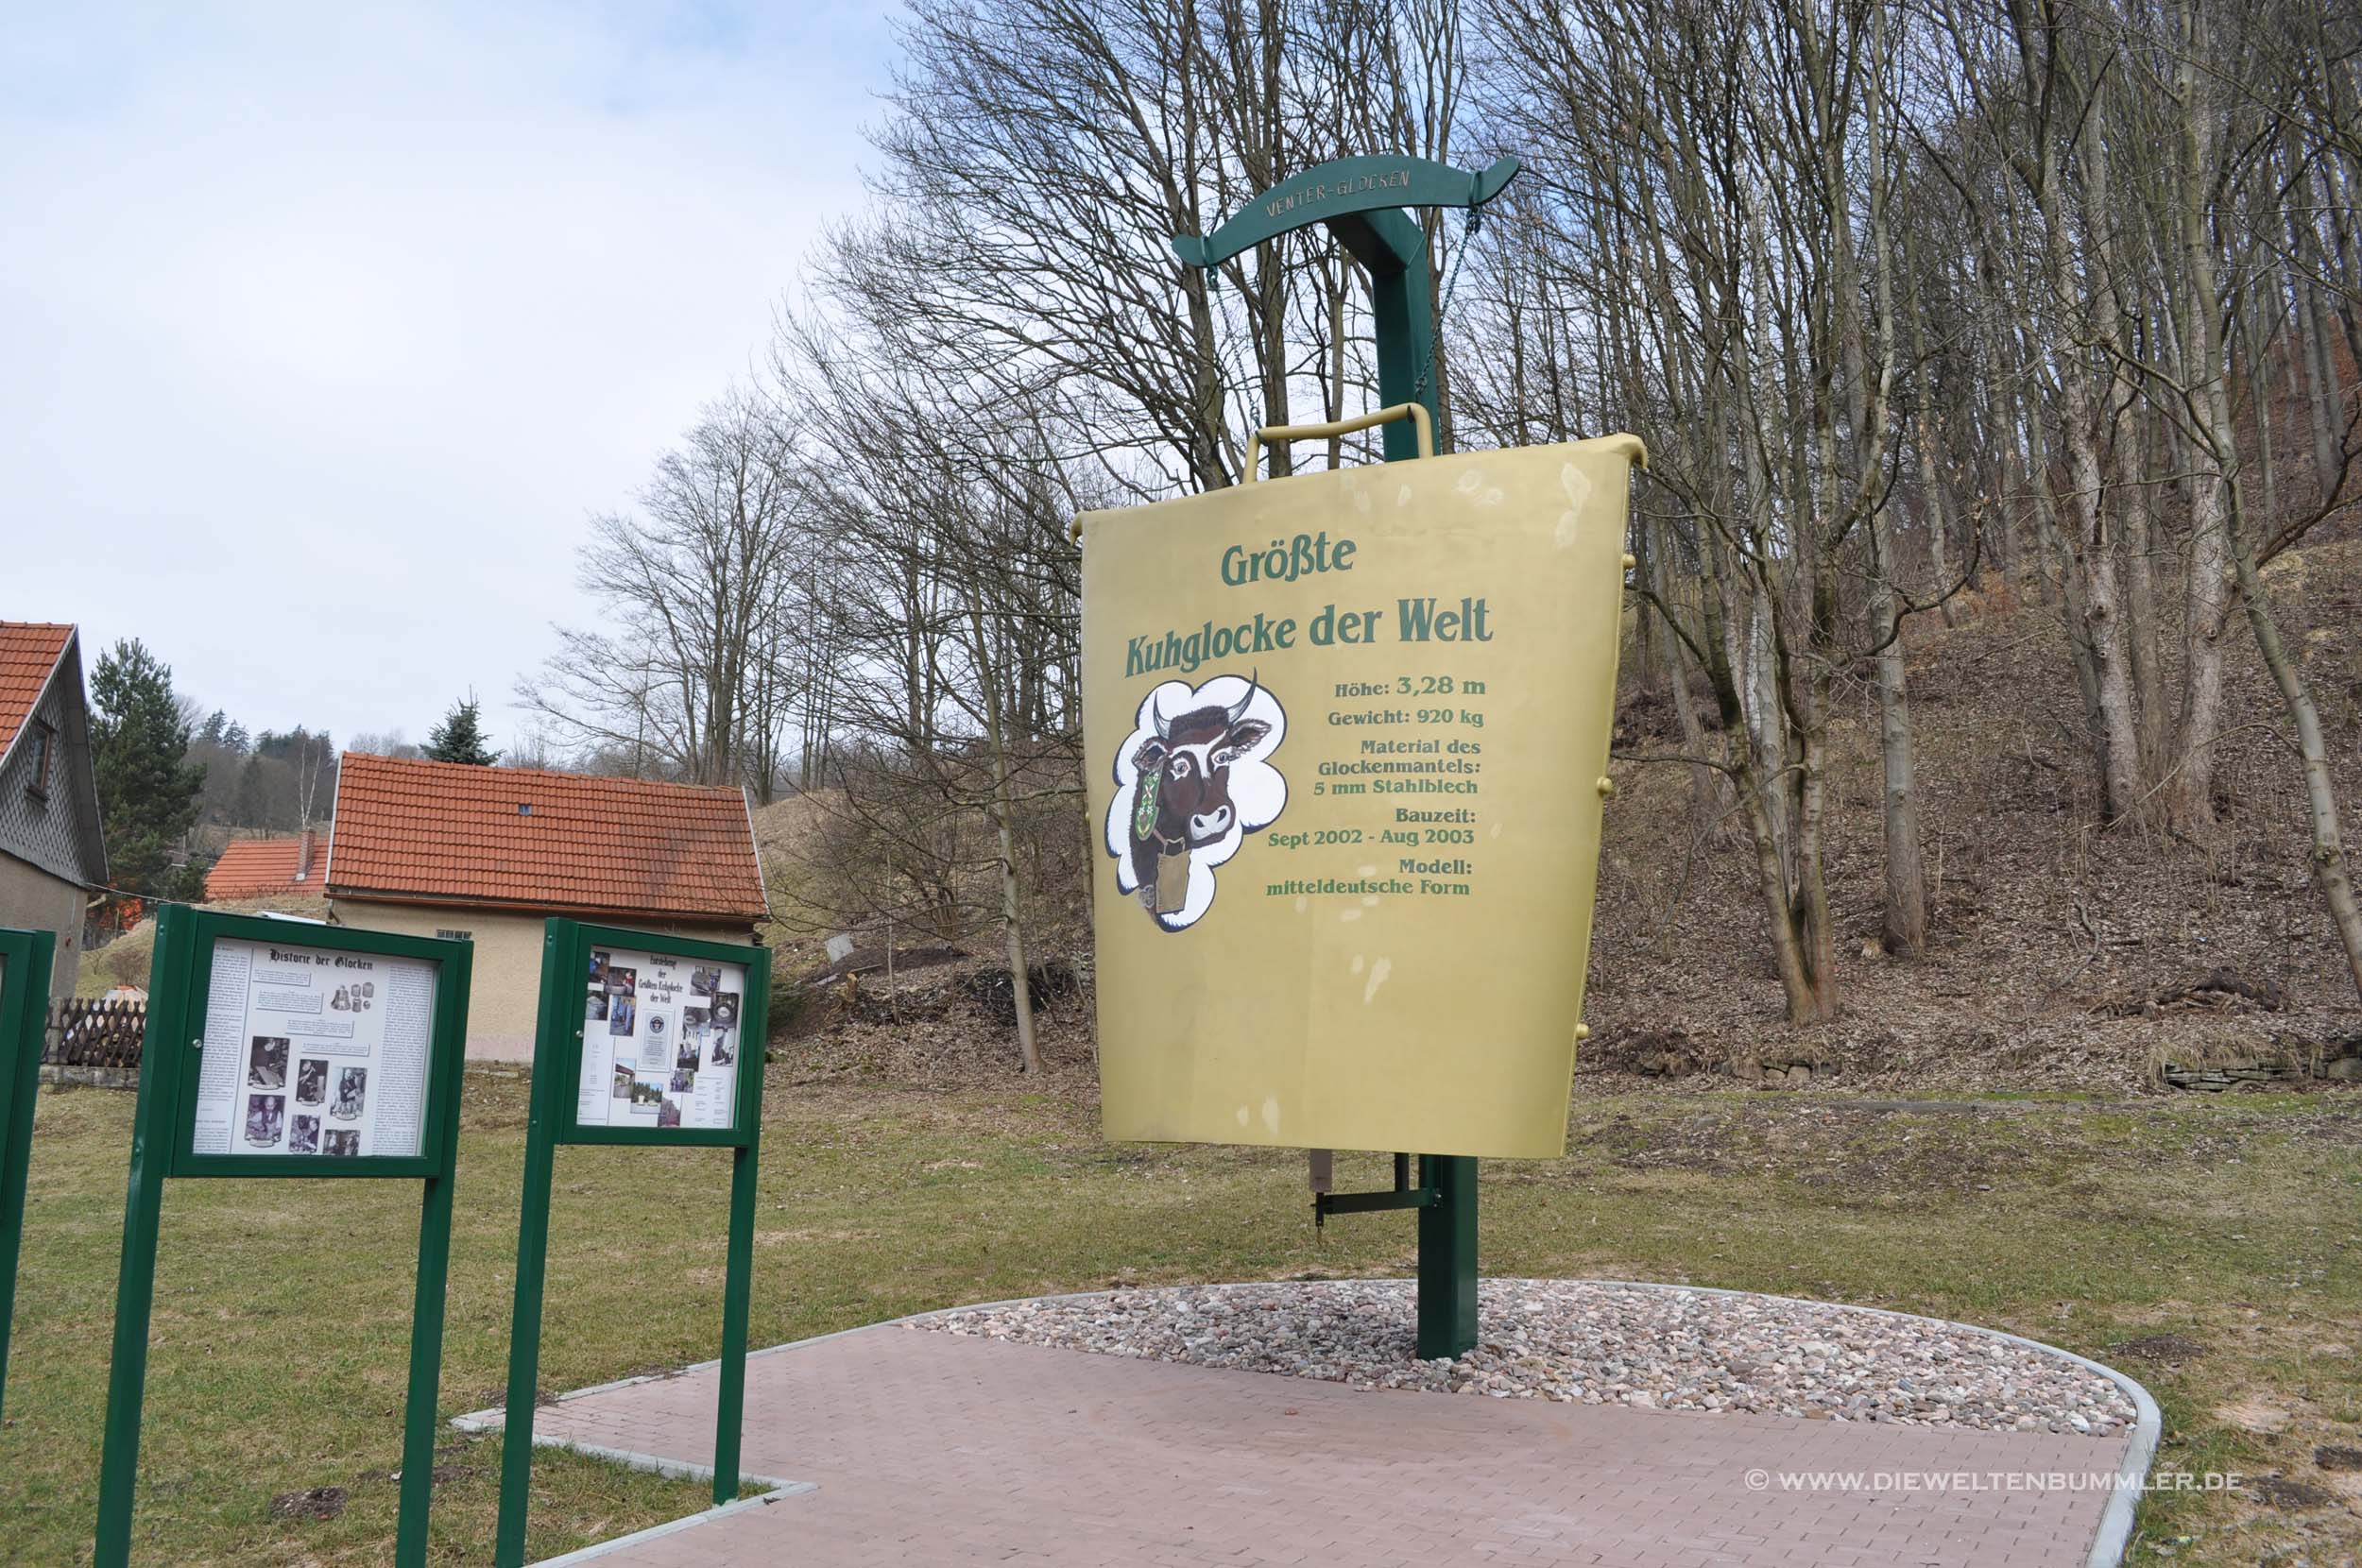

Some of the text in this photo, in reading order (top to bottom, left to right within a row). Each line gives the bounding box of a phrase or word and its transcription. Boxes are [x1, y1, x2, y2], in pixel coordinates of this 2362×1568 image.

[1220, 531, 1358, 587] Größte
[1124, 598, 1494, 678] Kuhglocke der Welt
[1334, 676, 1487, 698] Höhe: 3,28 m
[1327, 710, 1485, 728] Gewicht: 920 kg
[1361, 740, 1481, 755] Material des
[1318, 758, 1481, 776] Glockenmantels:
[1313, 778, 1479, 795] 5 mm Stahlblech
[1395, 808, 1477, 824] Bauzeit:
[1268, 831, 1309, 849] Sept
[1314, 830, 1363, 846] 2002
[1380, 829, 1419, 848] Aug
[1425, 829, 1475, 845] 2003
[1399, 859, 1473, 875] Modell:
[1266, 878, 1470, 896] mitteldeutsche Form
[269, 948, 373, 970] Historie der Glocken
